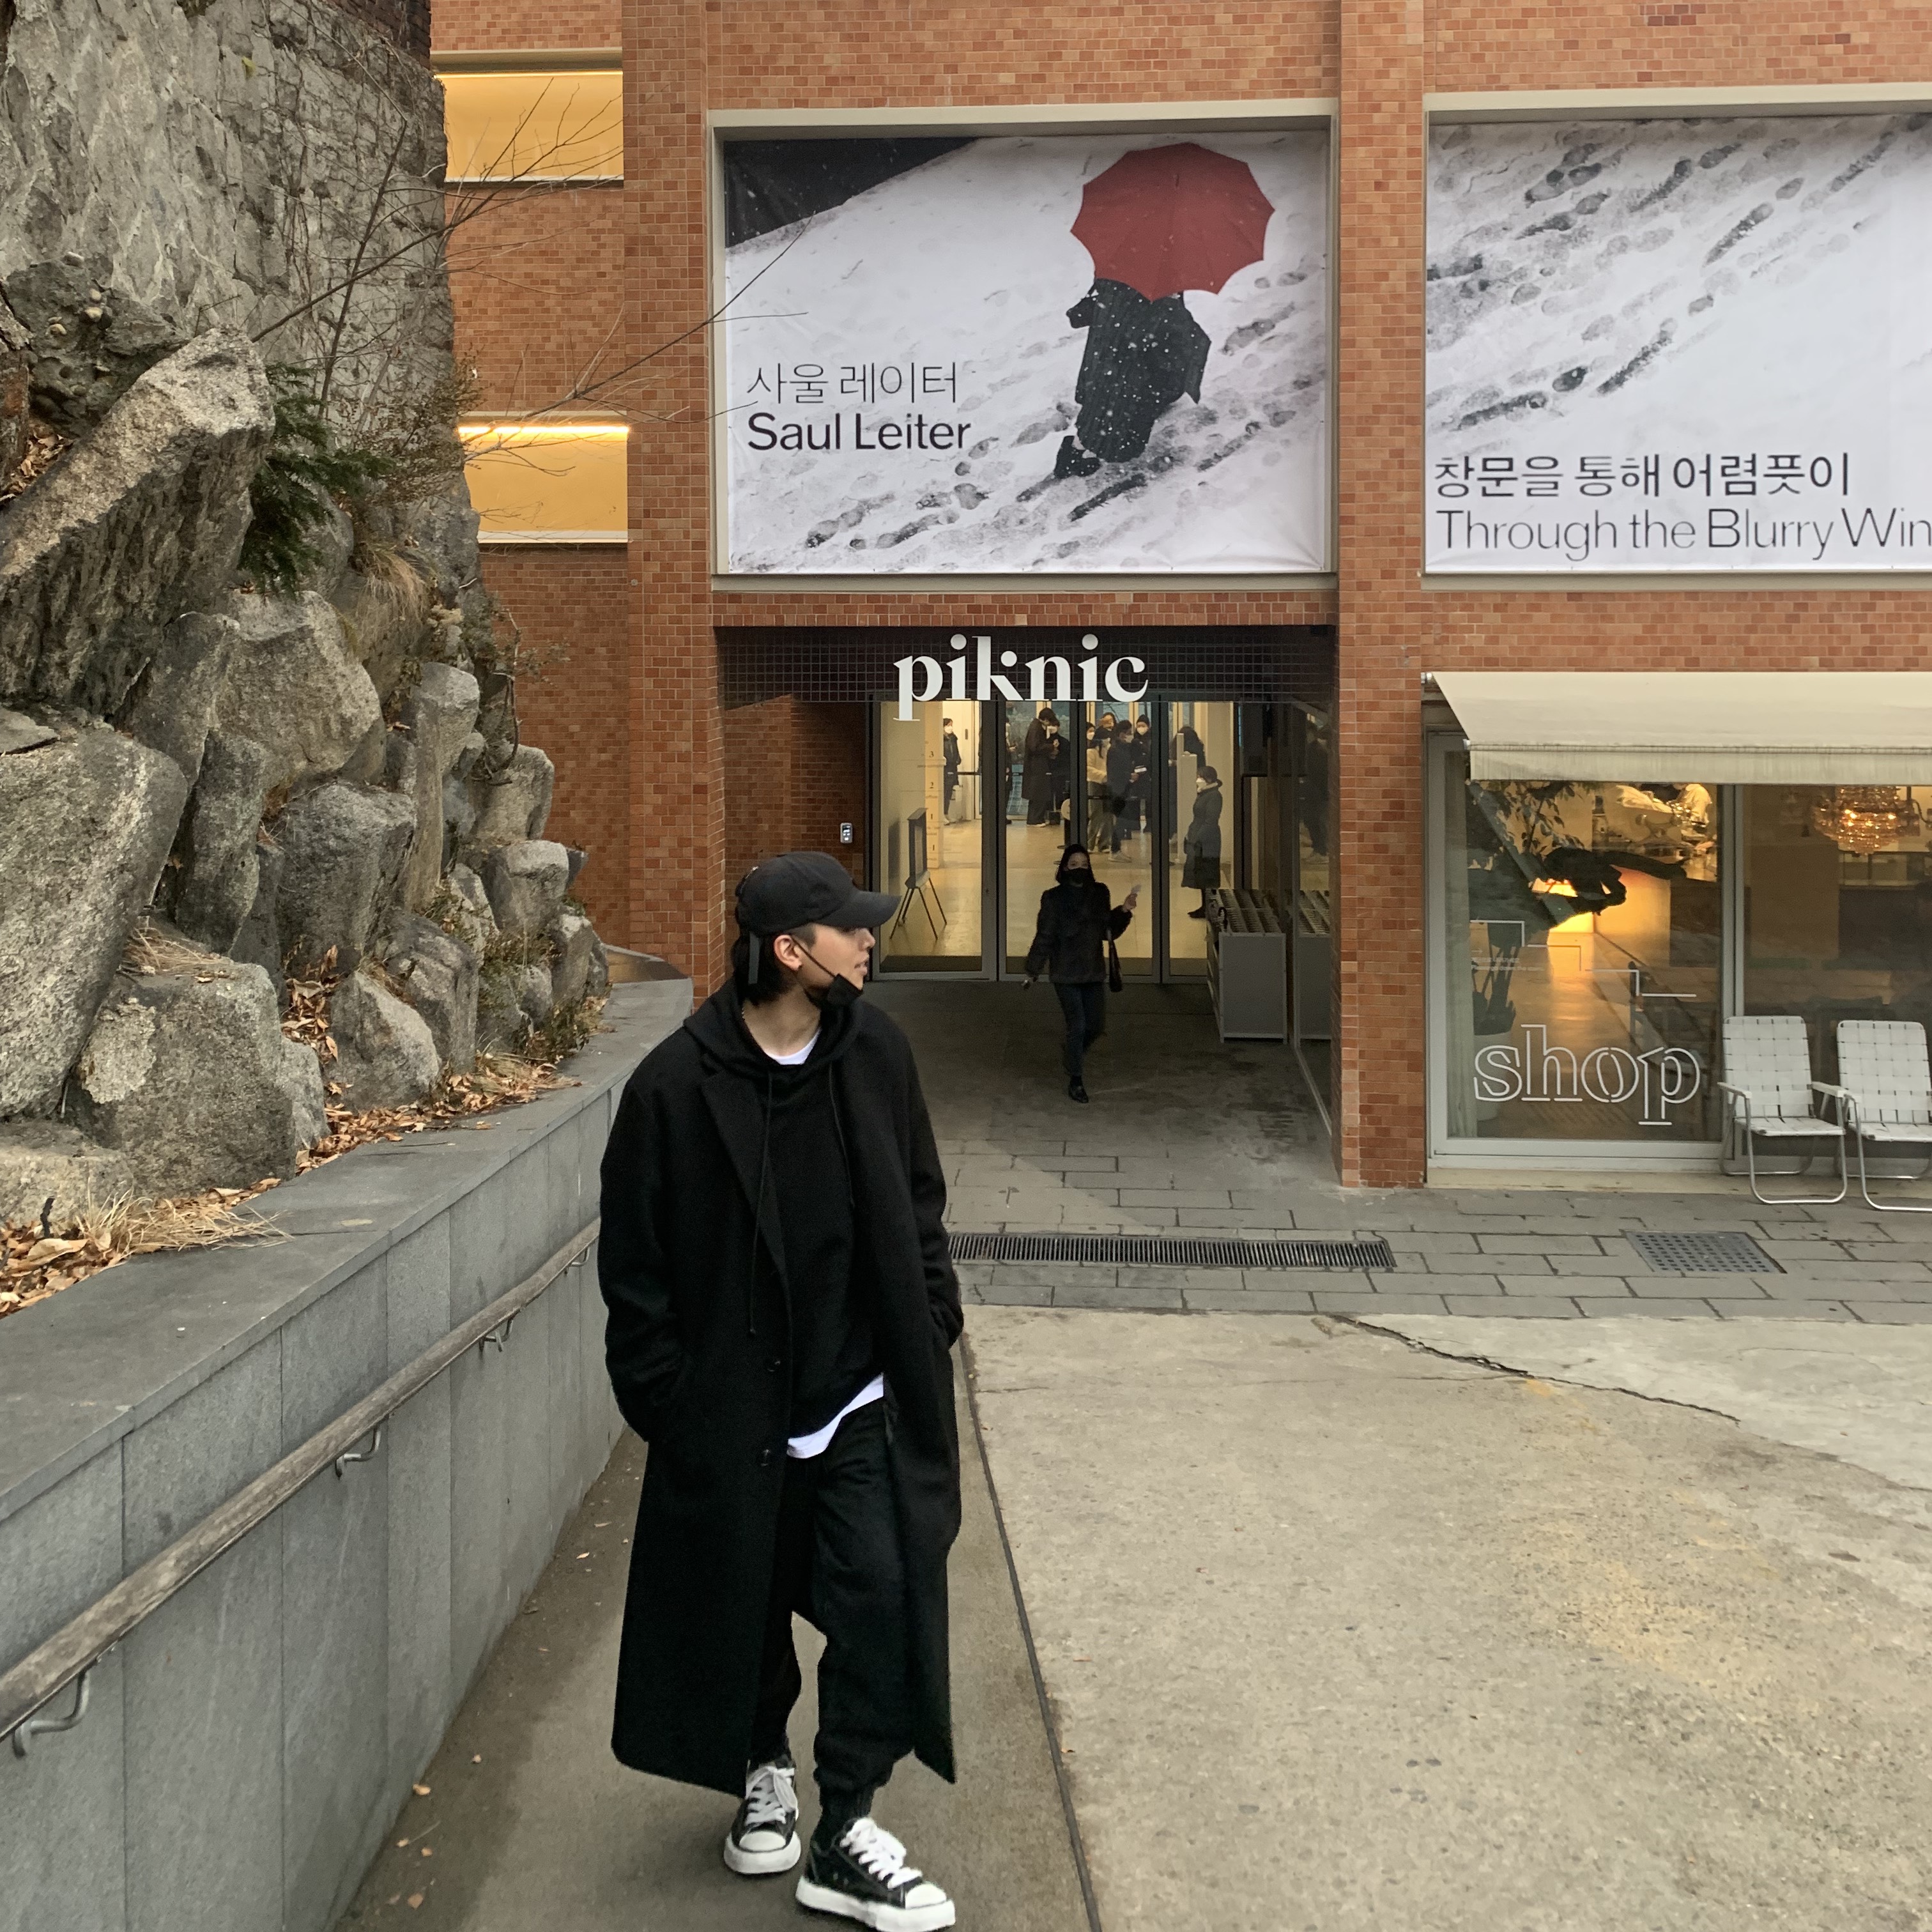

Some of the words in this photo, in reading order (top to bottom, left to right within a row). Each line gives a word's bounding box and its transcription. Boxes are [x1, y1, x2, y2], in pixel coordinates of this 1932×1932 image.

[747, 362, 829, 404] 사울
[840, 362, 956, 404] 레이터
[747, 412, 841, 450] Saul
[855, 412, 971, 450] Leiter
[1434, 454, 1563, 498] 창문을
[1575, 454, 1660, 496] 통해
[1673, 452, 1848, 496] 어렴풋이
[1436, 509, 1618, 562] Through
[1629, 509, 1696, 549] the
[1708, 507, 1834, 561] Blurry
[1841, 507, 1931, 548] Win
[893, 633, 1149, 721] piknic
[1473, 1024, 1701, 1126] shop
